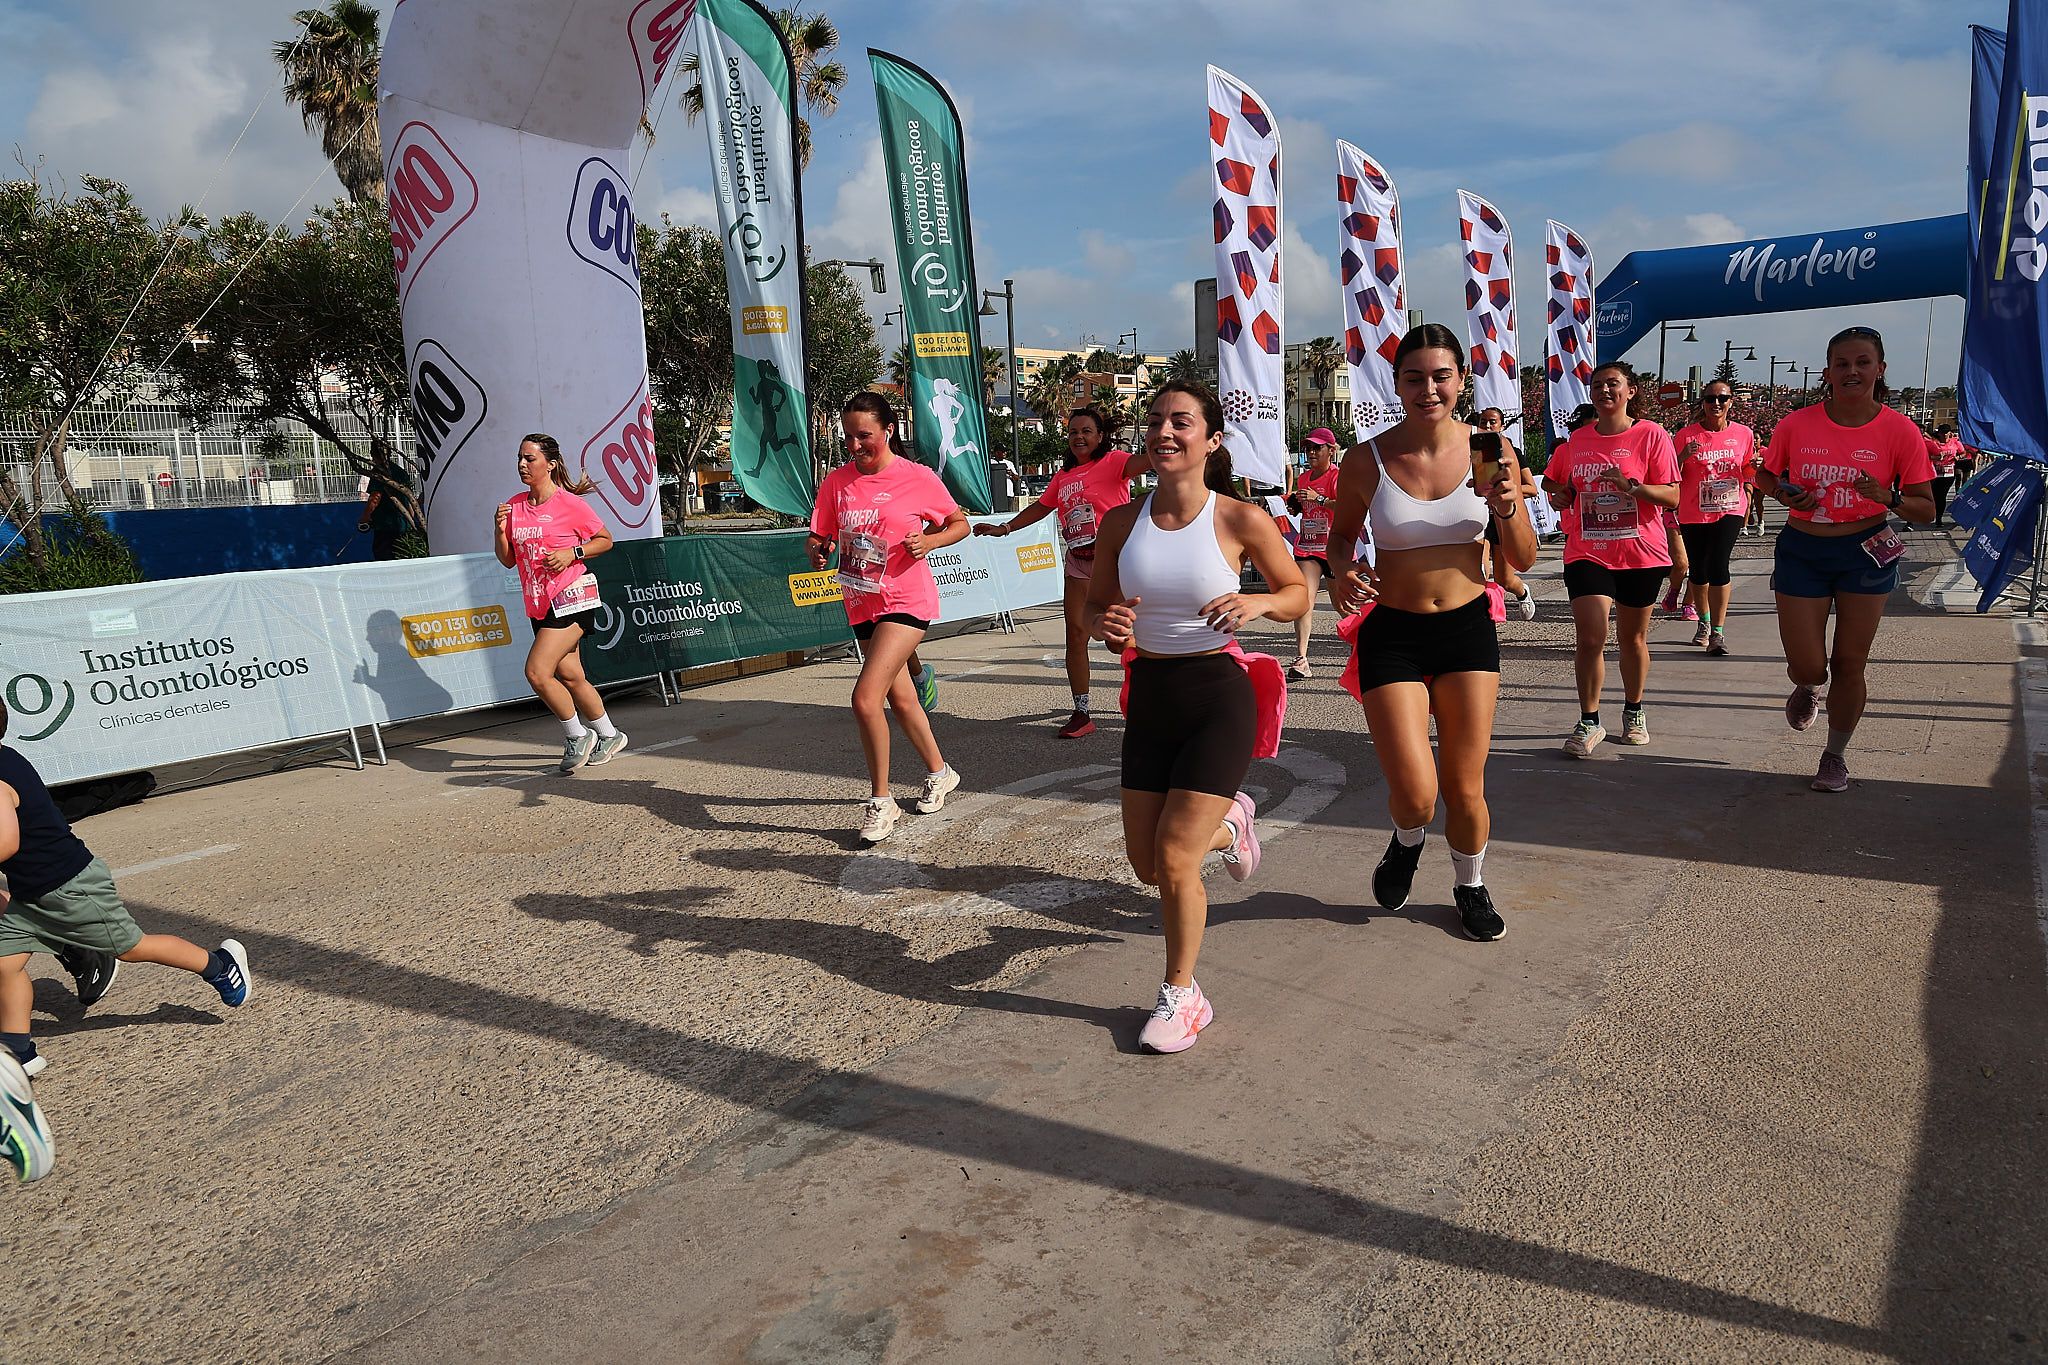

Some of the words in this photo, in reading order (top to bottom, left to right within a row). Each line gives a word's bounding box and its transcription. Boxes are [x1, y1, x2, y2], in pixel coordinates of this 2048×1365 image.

[1800, 447, 1829, 455] OYSHO
[1833, 487, 1854, 509] DE
[1597, 513, 1619, 522] 016
[512, 526, 543, 539] ARRERA
[1886, 534, 1900, 548] 01
[926, 552, 962, 568] titutos
[792, 575, 811, 589] 900
[933, 566, 989, 585] ontológicos
[624, 580, 703, 604] Institutos
[632, 597, 743, 626] Odontológicos
[409, 620, 443, 636] 900
[444, 616, 469, 632] 131
[471, 612, 501, 628] 002
[415, 629, 505, 651] www.ioa.es
[638, 632, 671, 644] Clínicas
[670, 626, 705, 640] dentales
[79, 635, 235, 674] Institutos
[90, 657, 310, 706] Odontológicos
[99, 709, 162, 730] Clínicas
[163, 697, 231, 720] dentales
